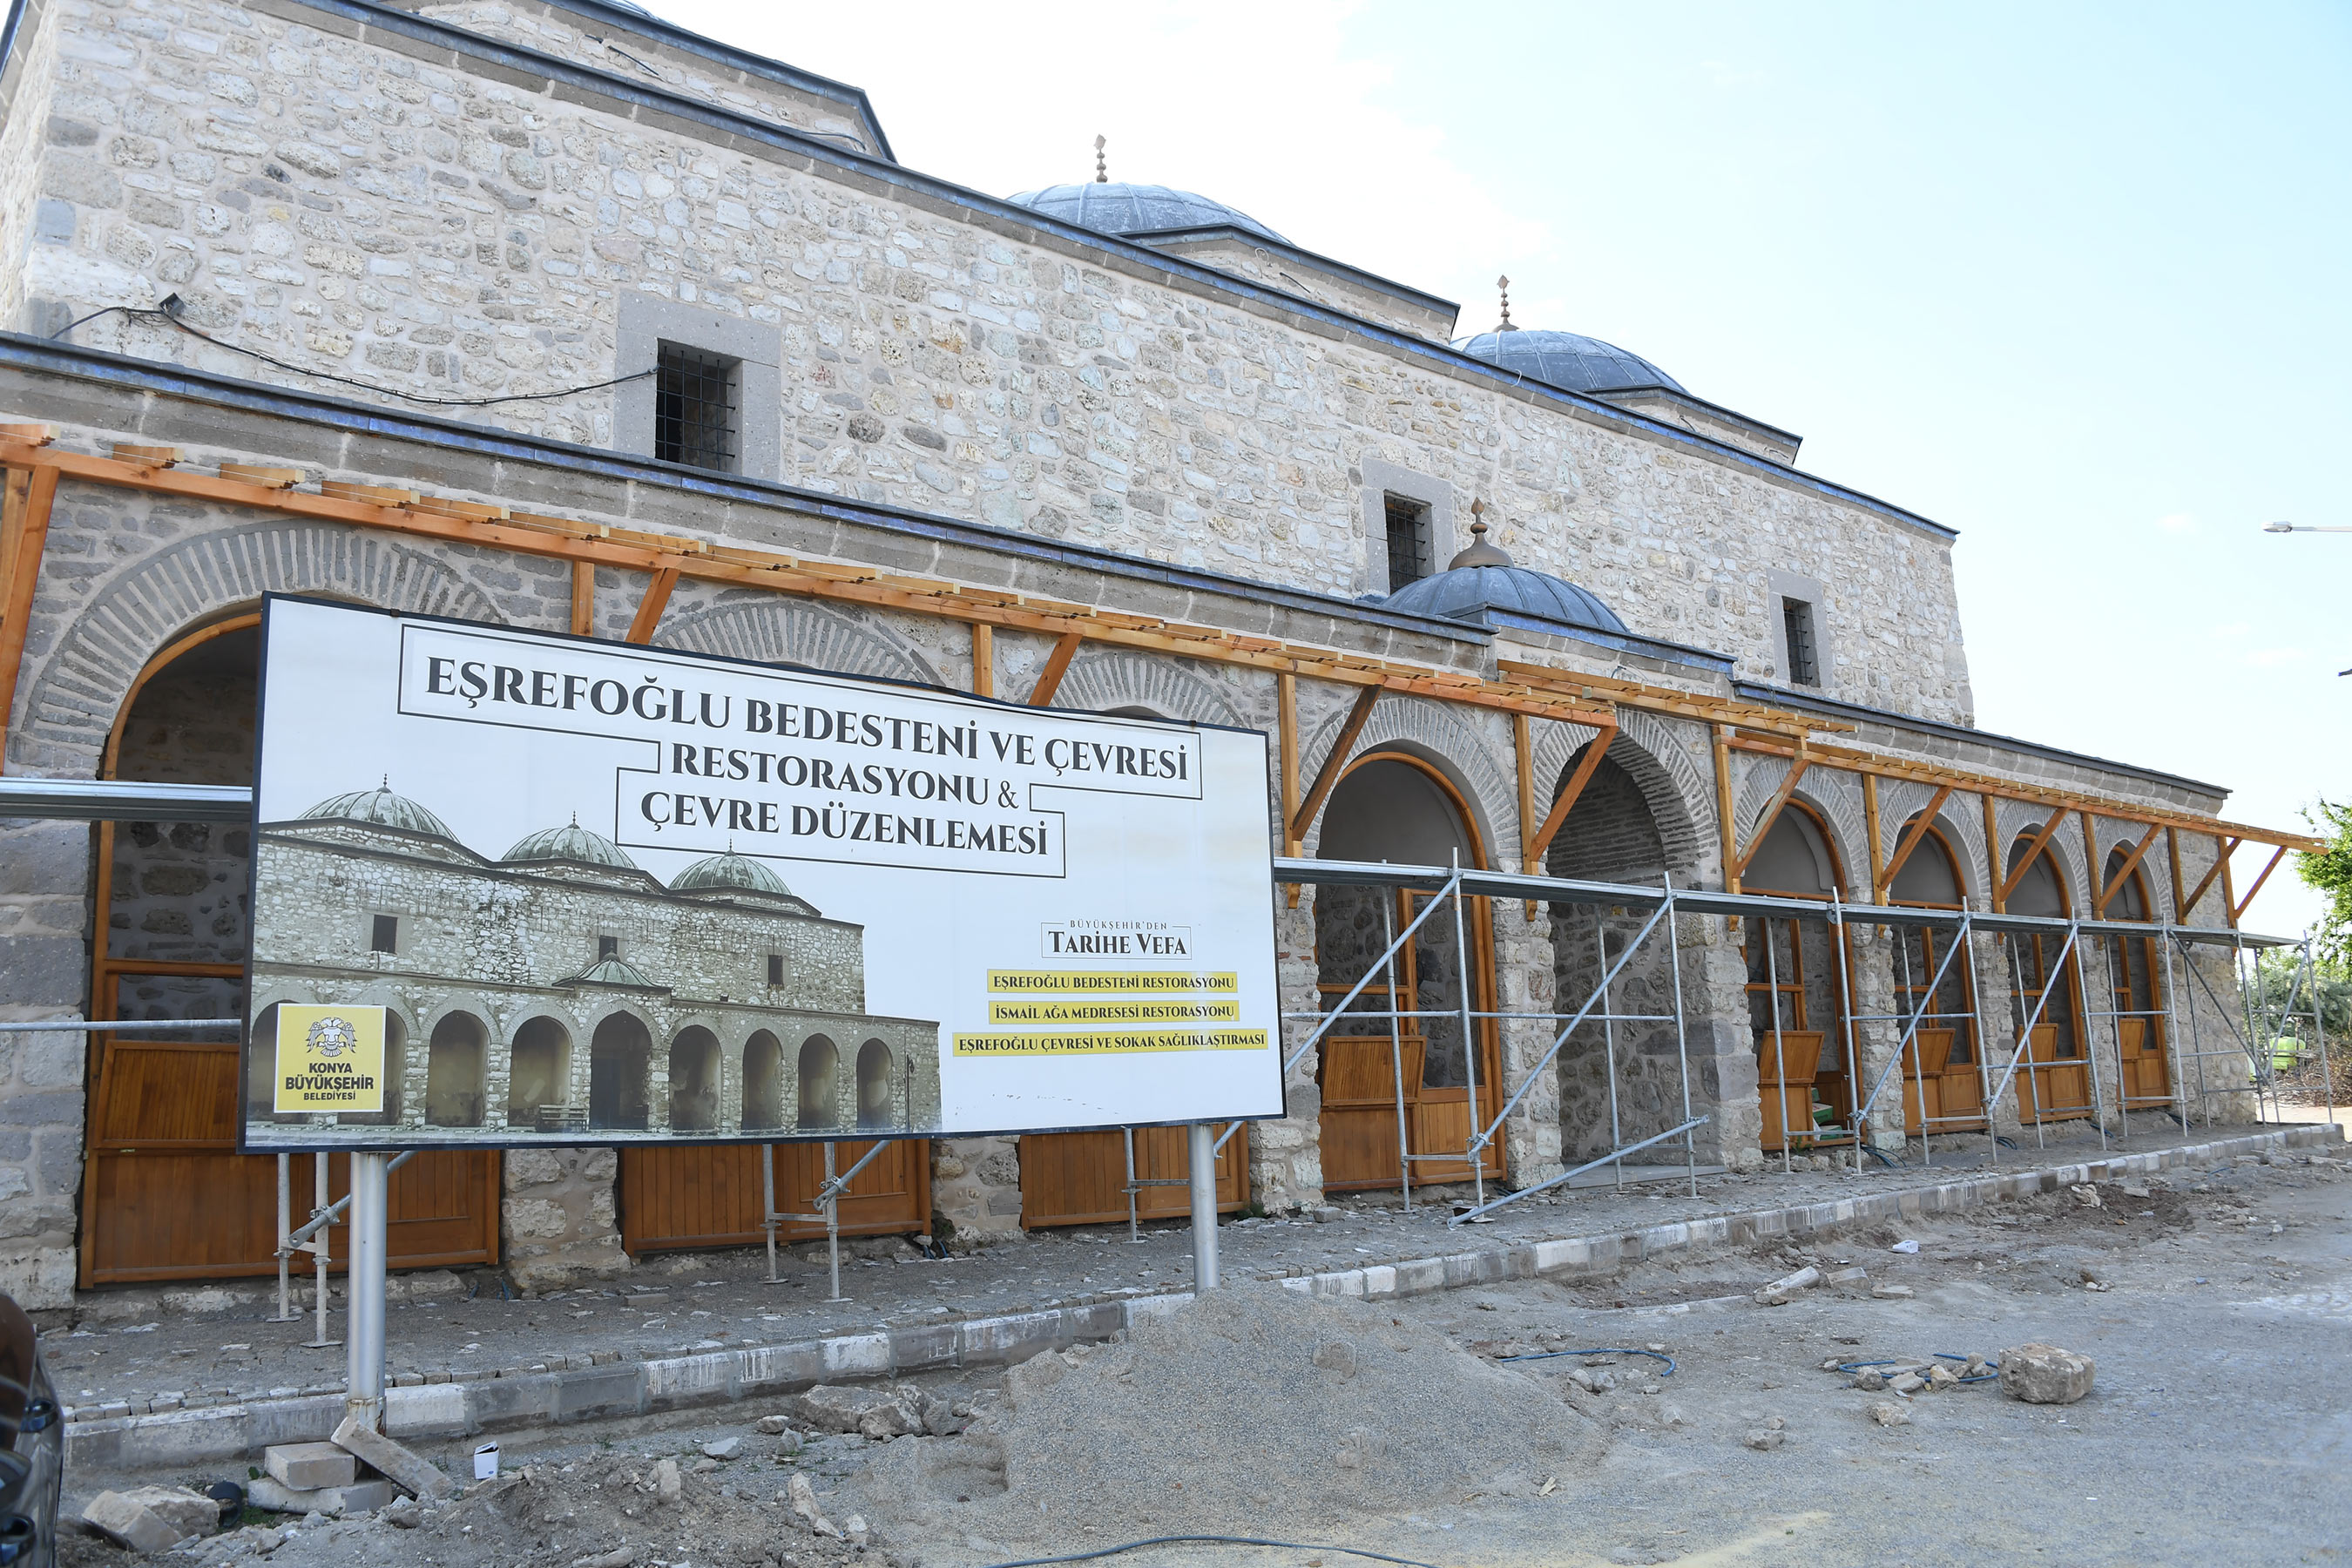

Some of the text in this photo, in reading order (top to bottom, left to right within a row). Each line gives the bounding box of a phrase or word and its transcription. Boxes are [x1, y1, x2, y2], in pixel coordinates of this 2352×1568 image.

[426, 657, 1188, 781] EŞREFOĞLU BEDESTENİ VE ÇEVRESİ
[671, 742, 1019, 808] RESTORASYONU &
[640, 791, 1048, 855] ÇEVRE DÜZENLEMESİ
[993, 974, 1234, 990] EŞREFOĞLU BEDESTENİ RESTORASYONU
[996, 1004, 1234, 1019] İSMAİL AĞA MEDRESESİ RESTORASYONU
[959, 1033, 1265, 1053] EŞREFOĞLU ÇEVRESİ VE SOKAK SAĞLIKLAŞTIRMASI
[308, 1063, 353, 1073] KONYA
[285, 1074, 374, 1092] BÜYÜKŞEHİR
[303, 1091, 356, 1100] BELEDİYESİ
